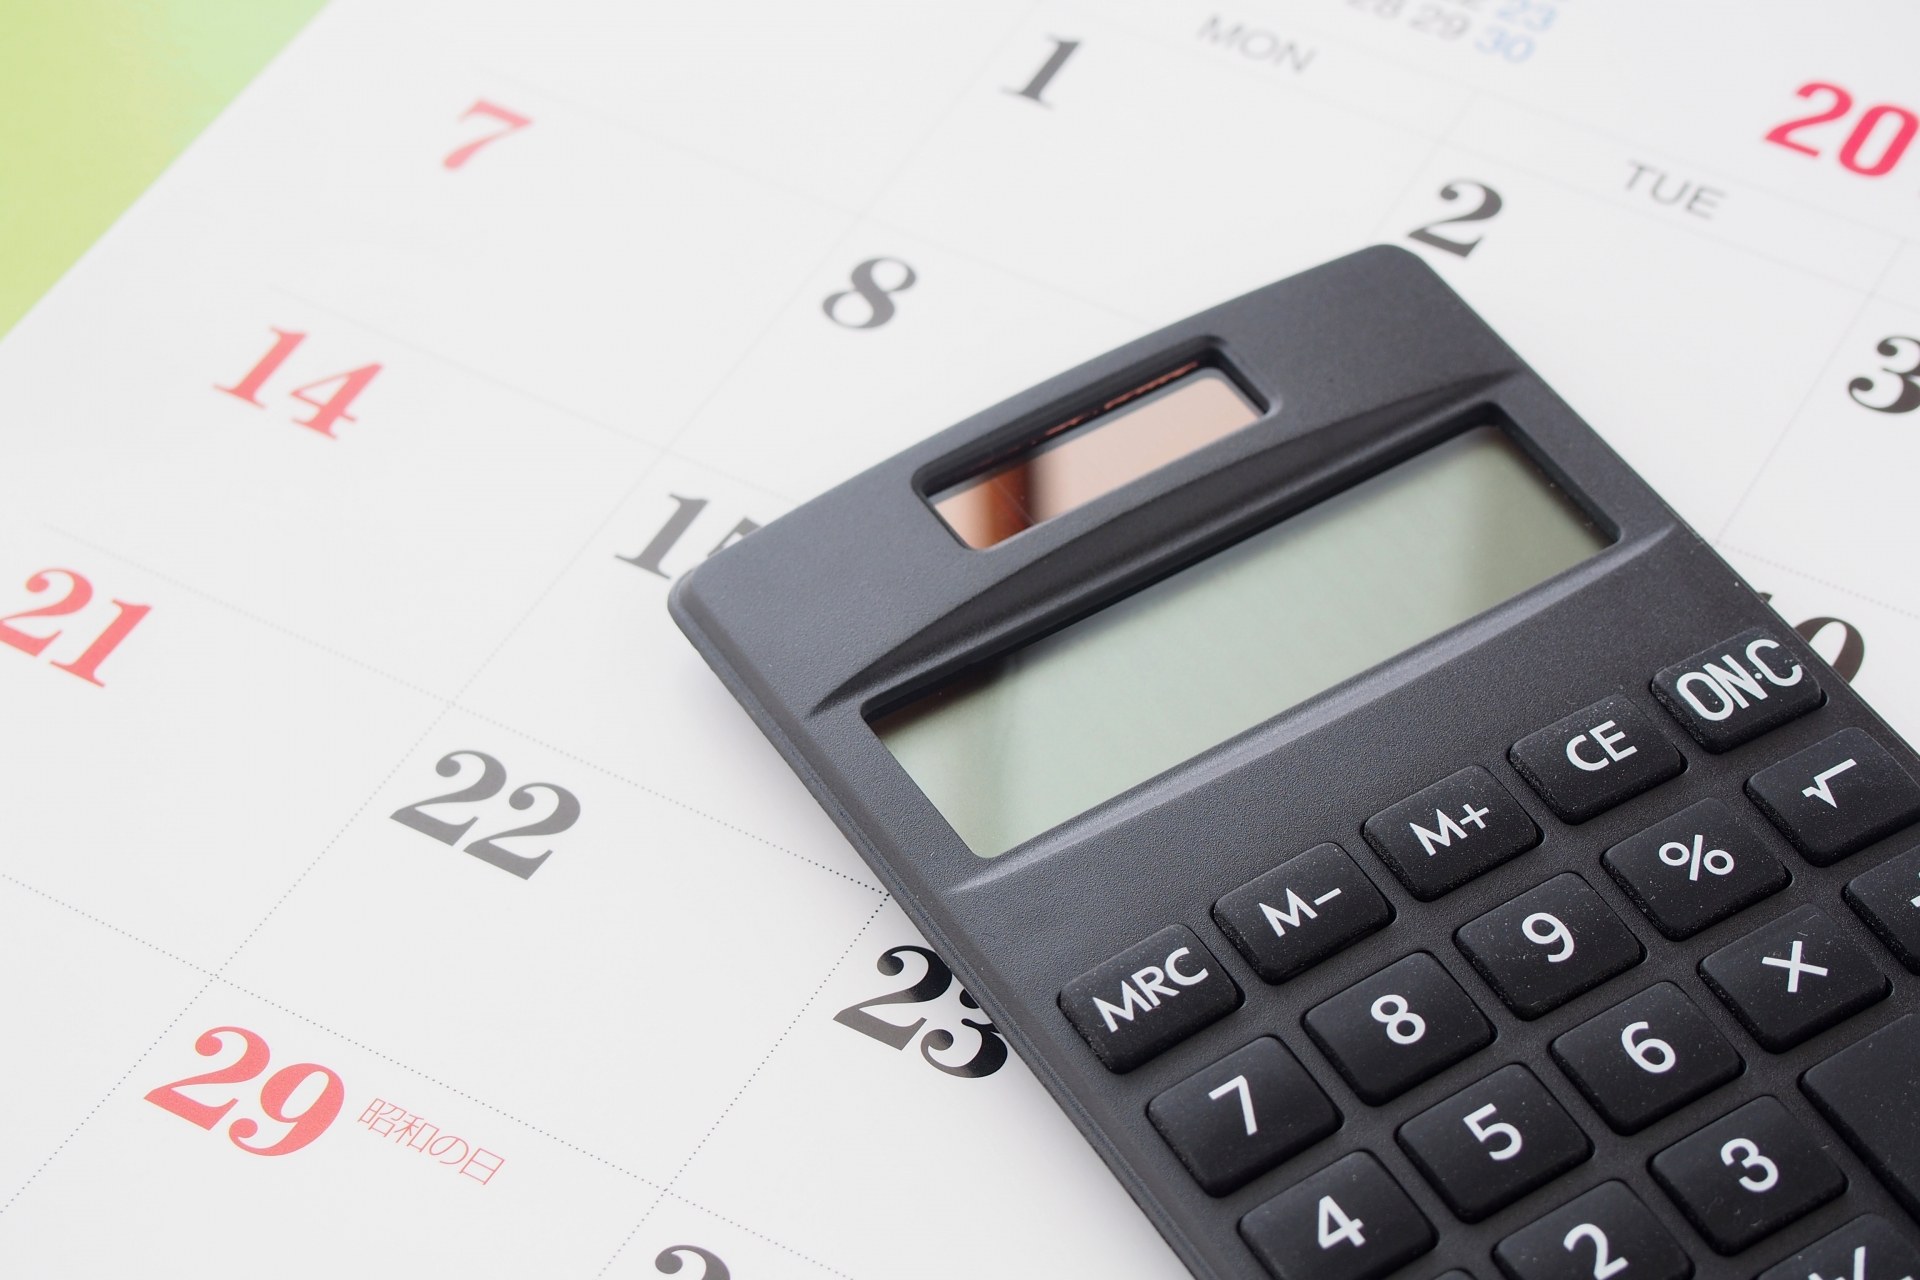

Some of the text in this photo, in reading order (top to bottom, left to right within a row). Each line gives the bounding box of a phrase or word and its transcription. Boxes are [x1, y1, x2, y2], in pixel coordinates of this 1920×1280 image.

[1004, 36, 1082, 108] 1
[1197, 13, 1317, 75] MON
[1474, 24, 1537, 65] 30
[443, 99, 532, 170] 7
[1762, 80, 1920, 177] 20
[1407, 178, 1503, 258] 2
[1625, 160, 1726, 220] TUE
[822, 256, 918, 330] 8
[213, 326, 383, 440] 14
[1847, 336, 1920, 415] 3
[0, 568, 152, 688] 21
[1566, 720, 1637, 771] CE
[389, 750, 581, 881] 22
[1409, 803, 1490, 856] M+
[1659, 834, 1735, 881] %
[1521, 912, 1576, 963] 9
[832, 945, 1008, 1079] 23
[1092, 946, 1209, 1033] MRC
[1370, 994, 1427, 1045] 8
[1621, 1021, 1677, 1075] 6
[143, 1025, 346, 1157] 29
[1208, 1074, 1260, 1136] 7
[357, 1097, 505, 1186] 昭和の日
[1463, 1103, 1523, 1161] 5
[1720, 1138, 1779, 1193] 3
[1317, 1194, 1366, 1250] 4
[1563, 1223, 1629, 1280] 2
